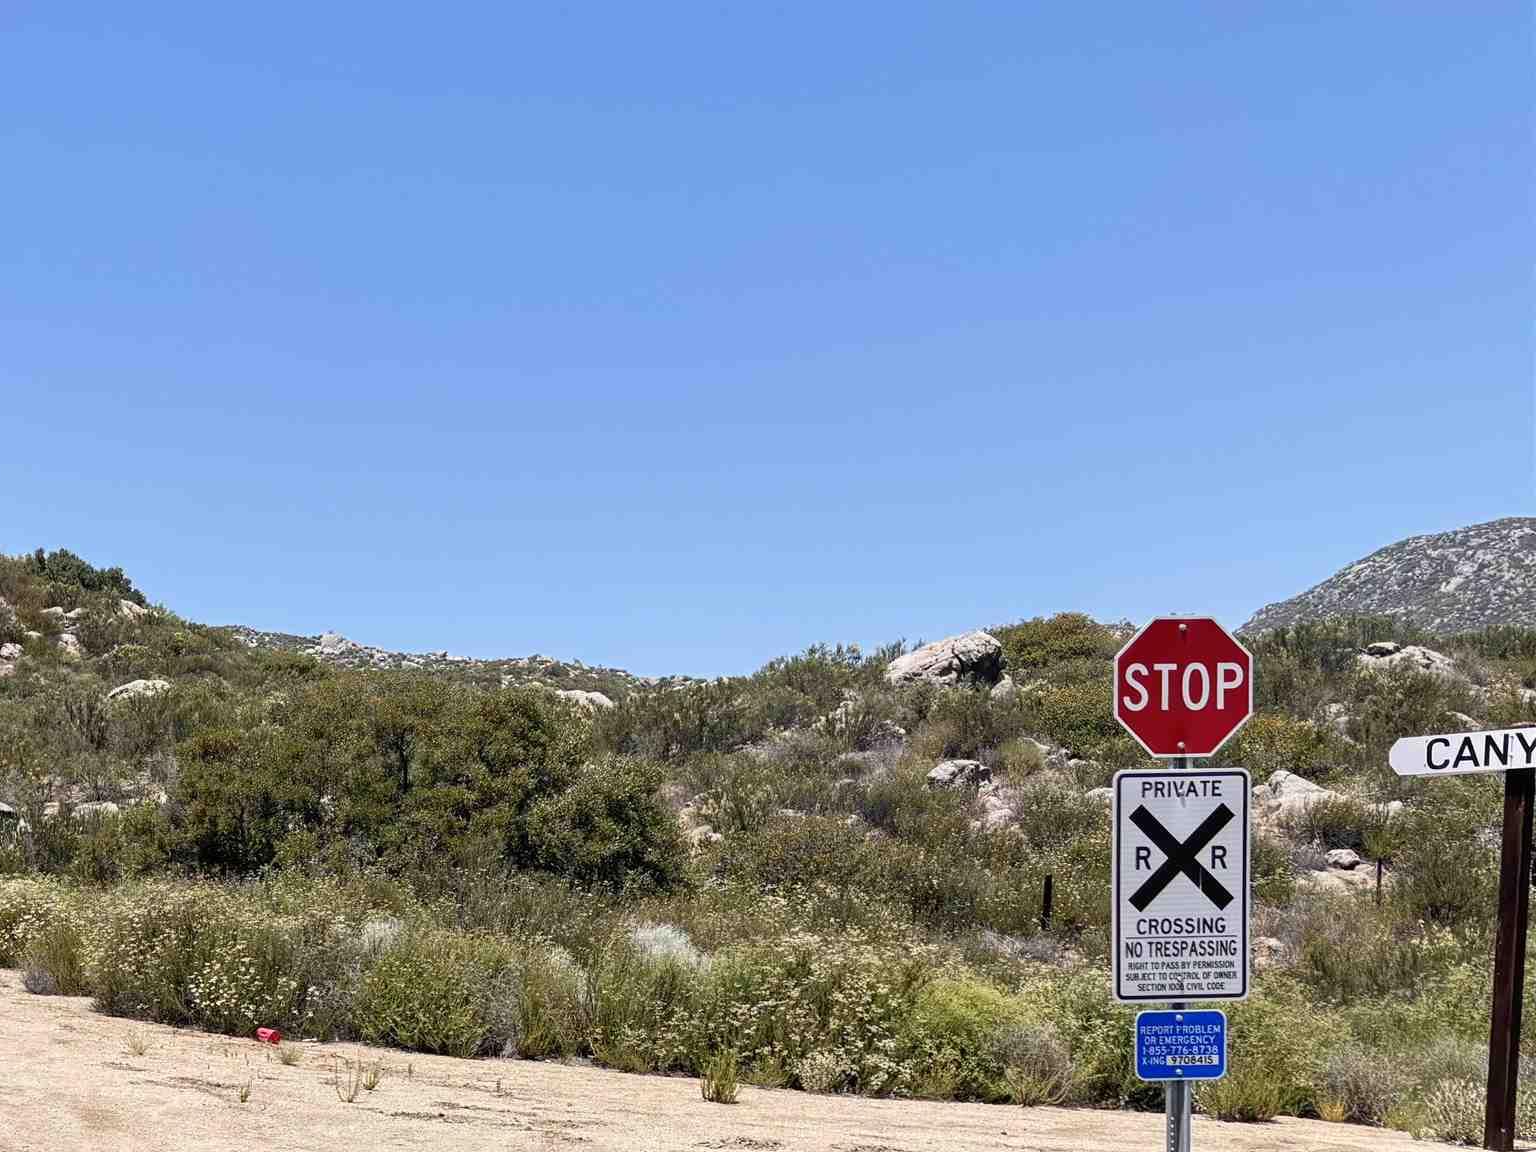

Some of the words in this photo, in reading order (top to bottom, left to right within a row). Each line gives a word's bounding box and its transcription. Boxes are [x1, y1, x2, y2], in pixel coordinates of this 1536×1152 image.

[1123, 662, 1244, 711] STOP
[1426, 732, 1536, 769] CANY
[1142, 780, 1222, 798] PRIVATE
[1135, 846, 1151, 870] R
[1211, 845, 1227, 869] R
[1136, 917, 1226, 935] CROSSING
[1125, 942, 1143, 958] NO
[1148, 940, 1237, 957] TRESPASSING
[1128, 962, 1148, 970] RIGHT
[1151, 962, 1160, 970] TO
[1162, 961, 1179, 969] PASS
[1181, 961, 1191, 969] BY
[1193, 960, 1235, 969] PERMISSION
[1125, 973, 1155, 981] SUBJECT
[1158, 972, 1168, 980] TO
[1168, 972, 1200, 981] CONTROL
[1202, 971, 1212, 979] OF
[1213, 970, 1238, 979] OWNER
[1137, 983, 1167, 991] SECTION
[1186, 982, 1204, 990] CIVIL
[1207, 981, 1225, 990] CODE
[1140, 1026, 1174, 1035] REPORT
[1177, 1025, 1221, 1034] PROBLEM
[1144, 1036, 1156, 1045] OR
[1159, 1035, 1216, 1045] EMERGENCY
